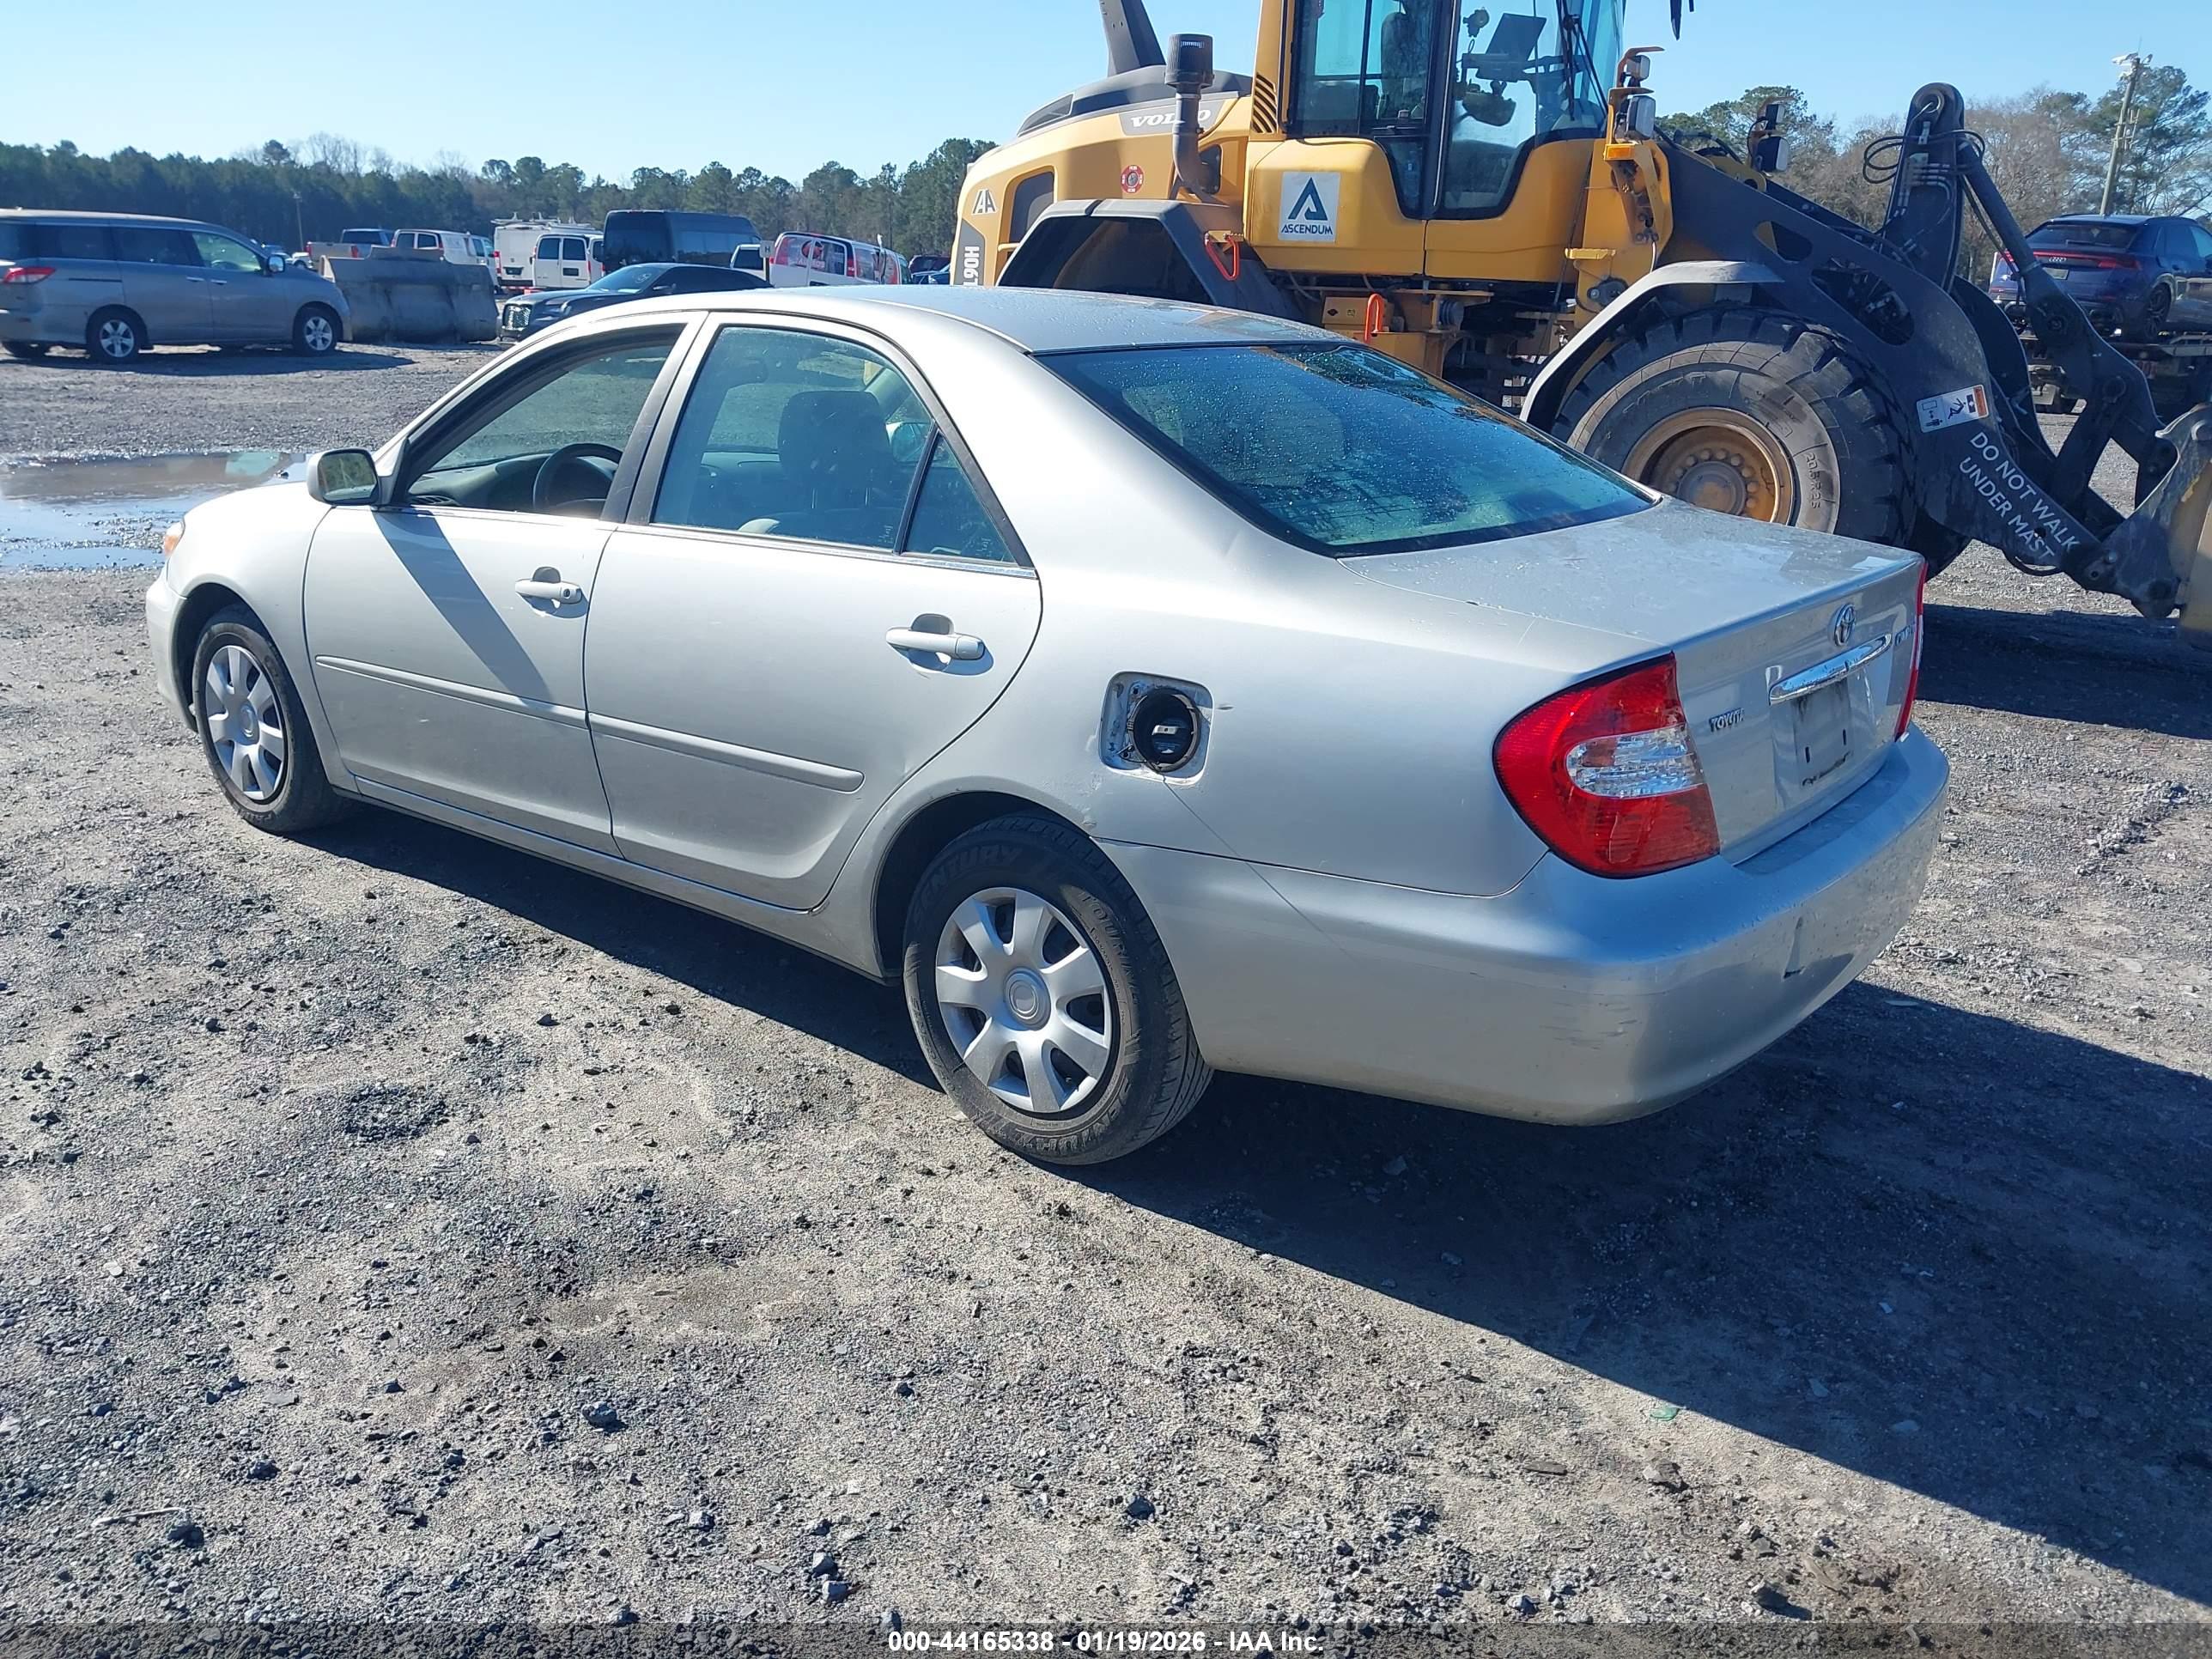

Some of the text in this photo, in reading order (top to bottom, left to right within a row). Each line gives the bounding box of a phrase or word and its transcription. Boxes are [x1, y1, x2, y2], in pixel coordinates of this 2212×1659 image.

[1131, 110, 1211, 128] VOLO
[1280, 223, 1334, 235] ASCENDUM
[963, 246, 980, 286] L90H
[1969, 431, 2081, 552] DO NOT WALK
[1960, 457, 2056, 559] UNDER MAST
[1709, 708, 1746, 732] TOYOTA
